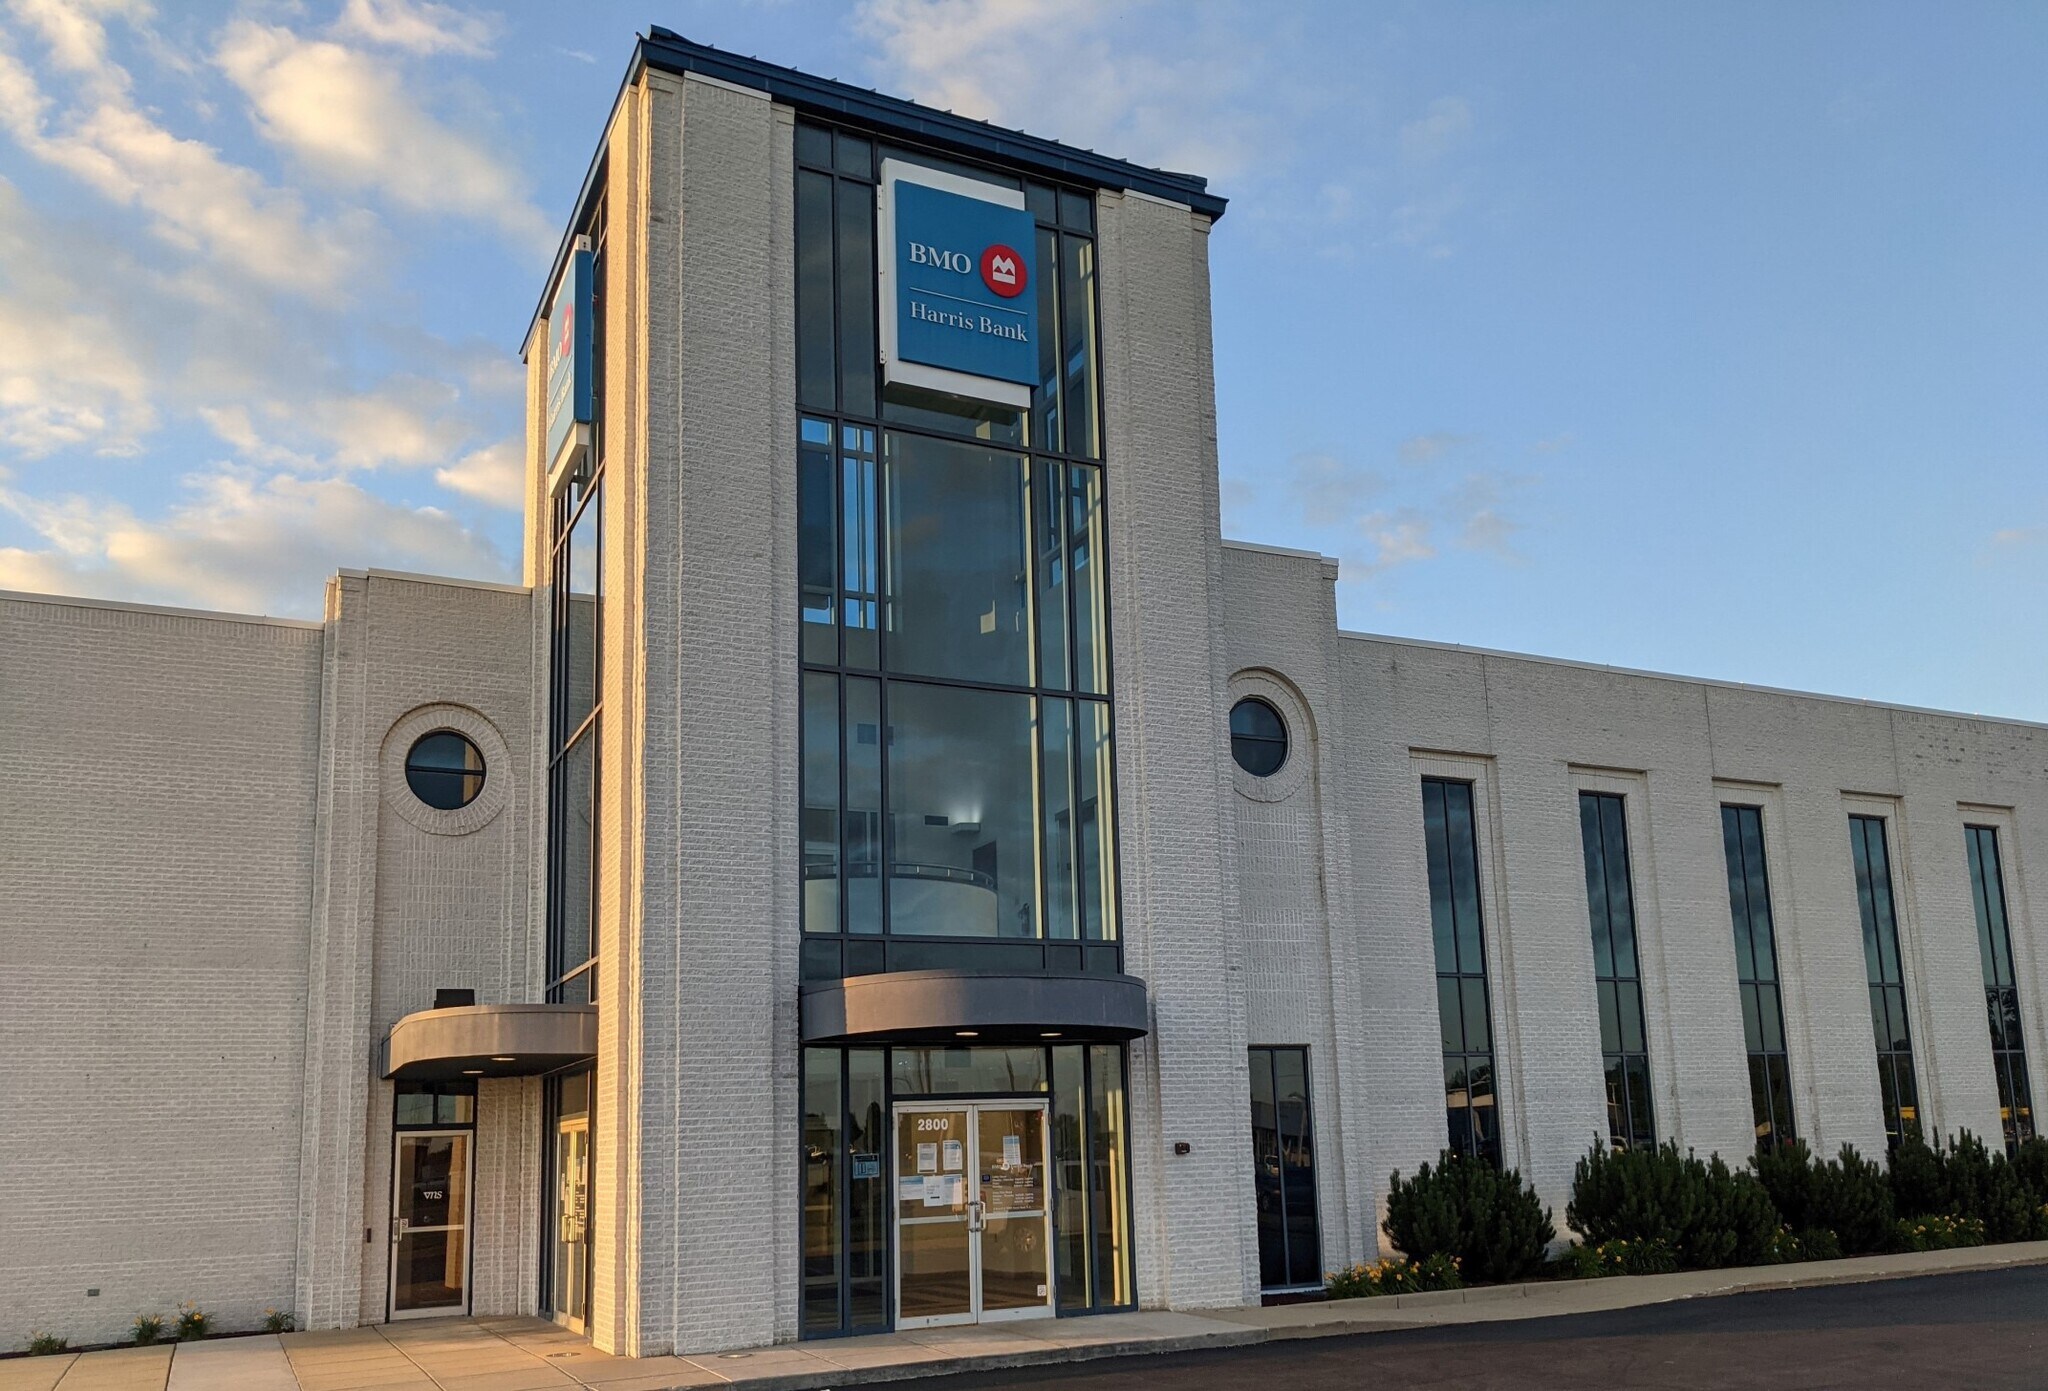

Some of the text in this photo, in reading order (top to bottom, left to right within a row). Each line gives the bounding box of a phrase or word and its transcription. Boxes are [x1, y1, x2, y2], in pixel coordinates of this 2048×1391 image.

[909, 241, 972, 274] BMO
[911, 301, 1028, 342] Harris Bank
[917, 1118, 949, 1131] 2800
